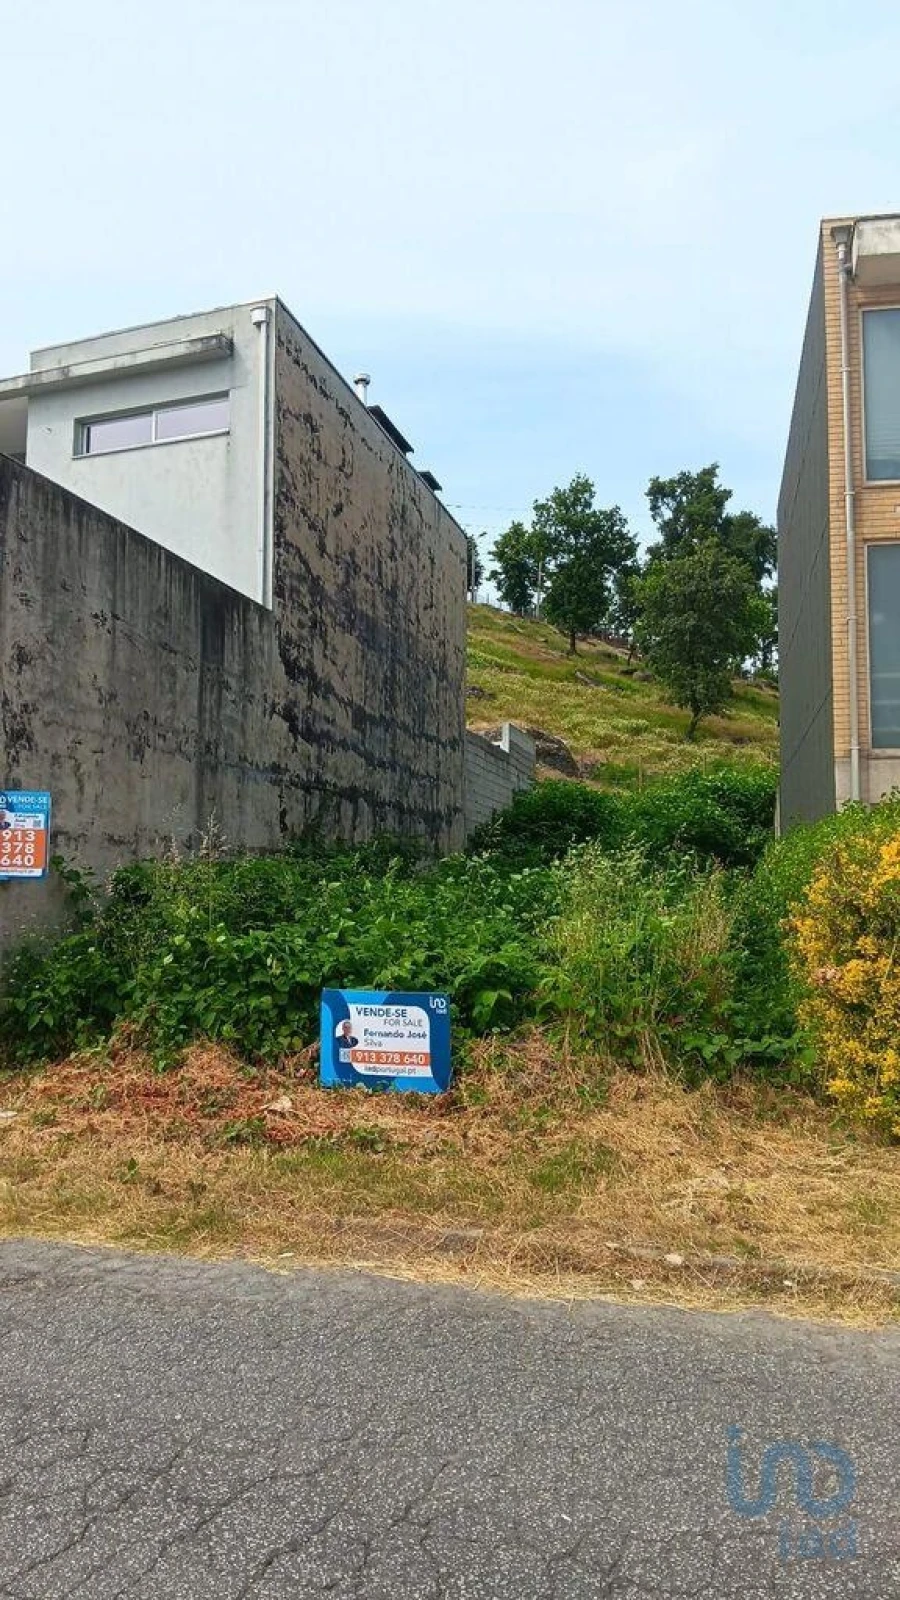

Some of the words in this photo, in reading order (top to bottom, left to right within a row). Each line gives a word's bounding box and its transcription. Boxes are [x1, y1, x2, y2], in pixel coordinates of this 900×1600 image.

[8, 796, 48, 804] VENDE-SE
[2, 830, 36, 842] 913
[2, 842, 35, 854] 378
[1, 854, 34, 867] 640
[355, 1007, 408, 1018] VENDE-SE
[383, 1018, 401, 1027] FOR
[402, 1019, 423, 1027] SALE
[363, 1029, 405, 1039] Fernando
[408, 1029, 428, 1040] José
[363, 1039, 383, 1048] Silva
[355, 1051, 376, 1063] 913
[379, 1052, 401, 1063] 378
[404, 1054, 426, 1065] 640
